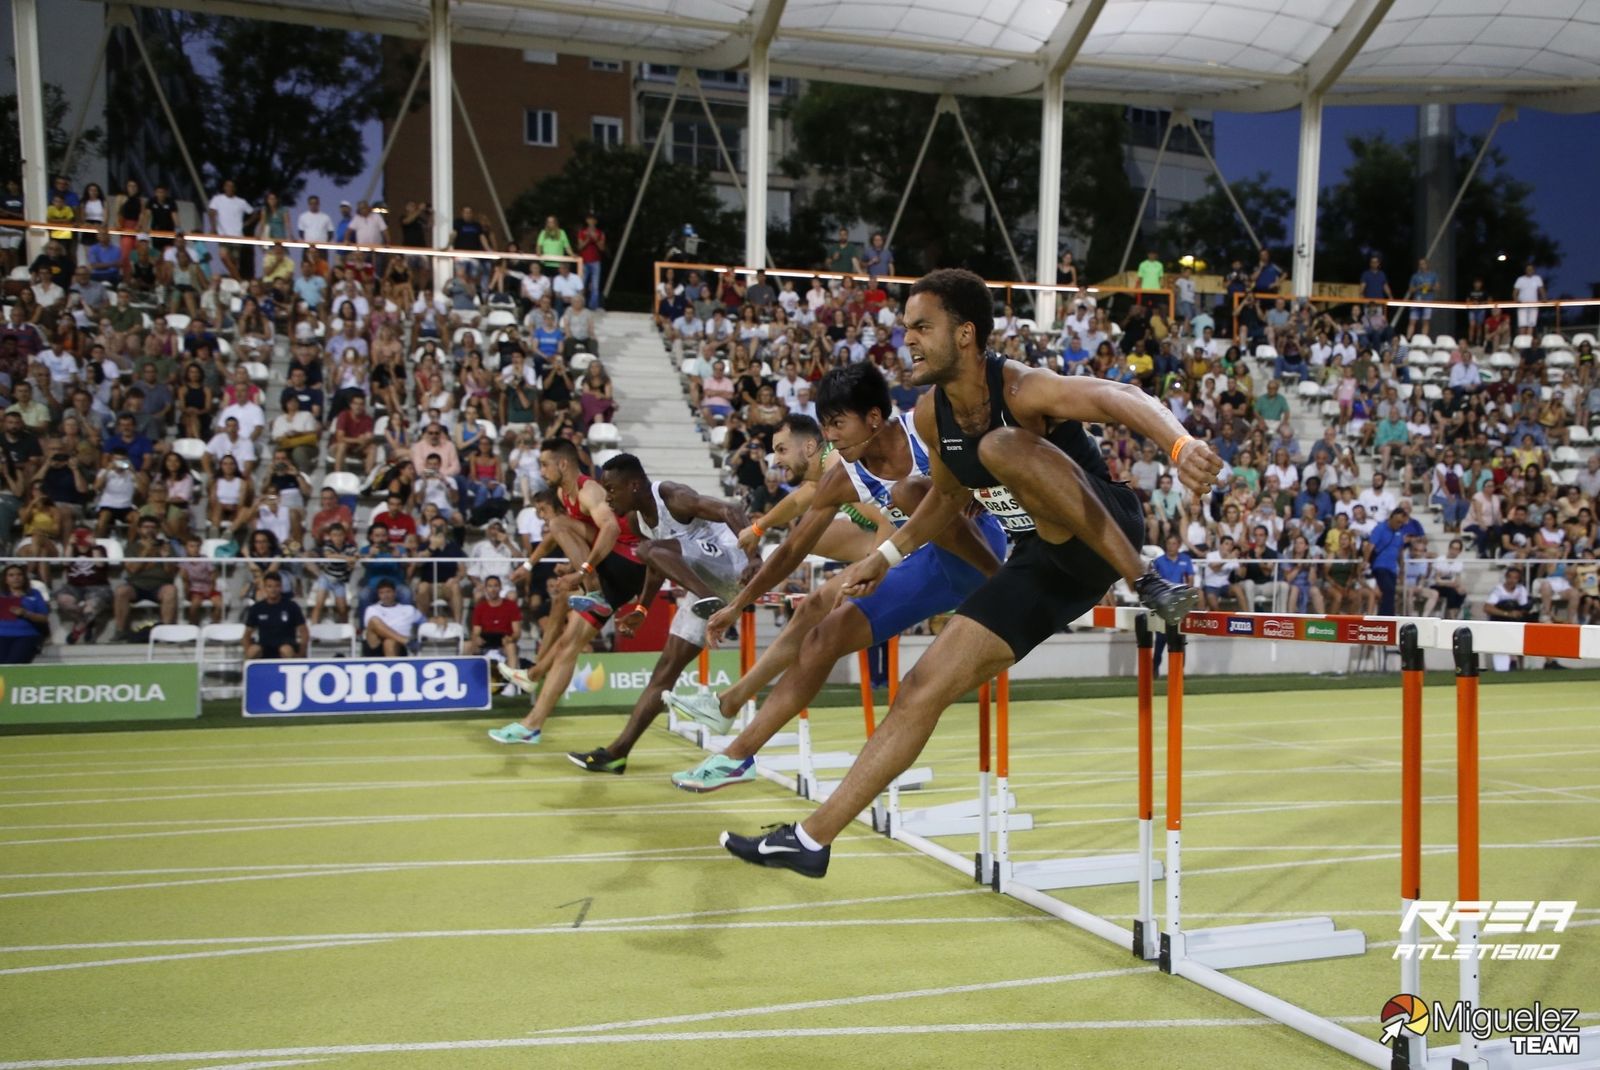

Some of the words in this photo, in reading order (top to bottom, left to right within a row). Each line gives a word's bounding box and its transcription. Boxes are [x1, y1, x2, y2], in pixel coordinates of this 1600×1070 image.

[985, 498, 1019, 512] OBAS
[1359, 625, 1388, 633] Comunidad
[1358, 633, 1366, 641] de
[1367, 633, 1388, 642] Madrid
[610, 670, 731, 689] IBEROLA
[11, 683, 166, 705] IBERDROLA
